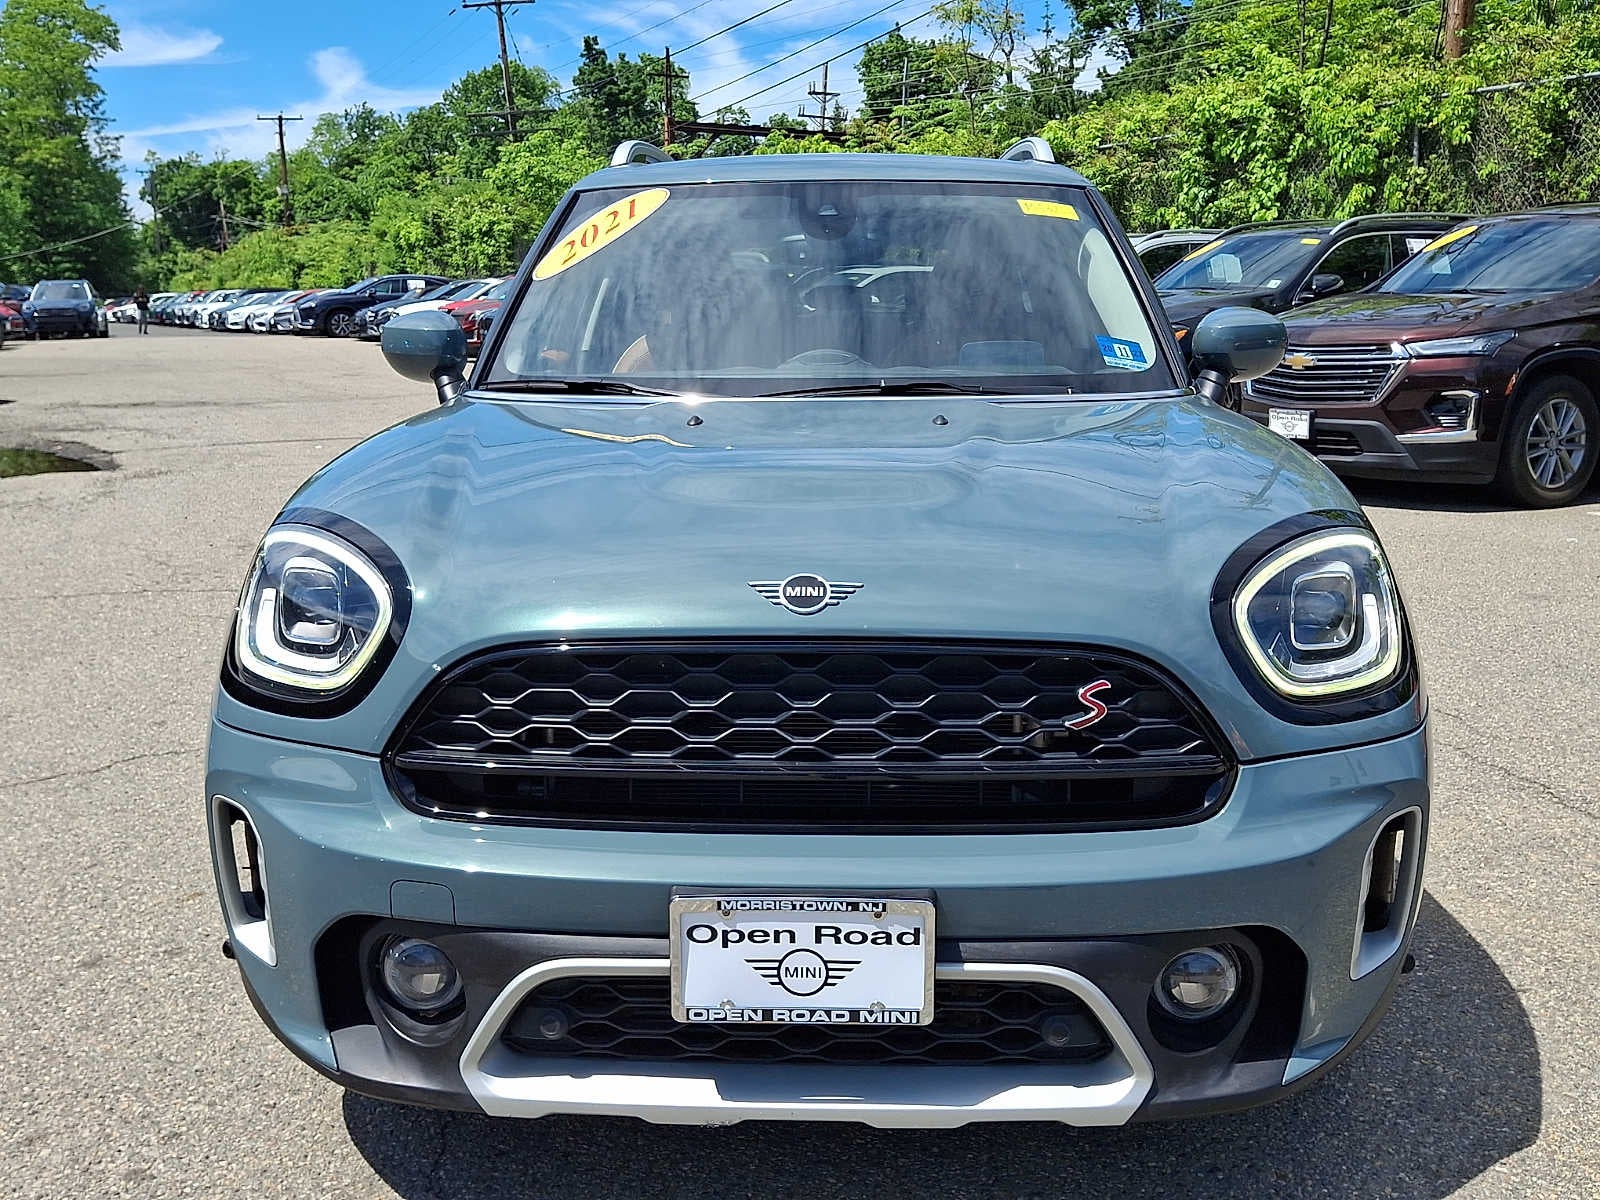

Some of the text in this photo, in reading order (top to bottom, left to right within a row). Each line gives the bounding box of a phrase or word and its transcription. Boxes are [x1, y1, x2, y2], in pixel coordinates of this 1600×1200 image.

[560, 199, 636, 265] 2021
[1116, 346, 1131, 358] 11
[785, 586, 824, 597] MINI
[1064, 680, 1111, 730] S
[720, 900, 884, 912] MORRISTOWN, NJ
[686, 924, 921, 948] Open Road
[784, 966, 822, 979] MINI
[688, 1009, 918, 1024] OPEN ROAD MINI
